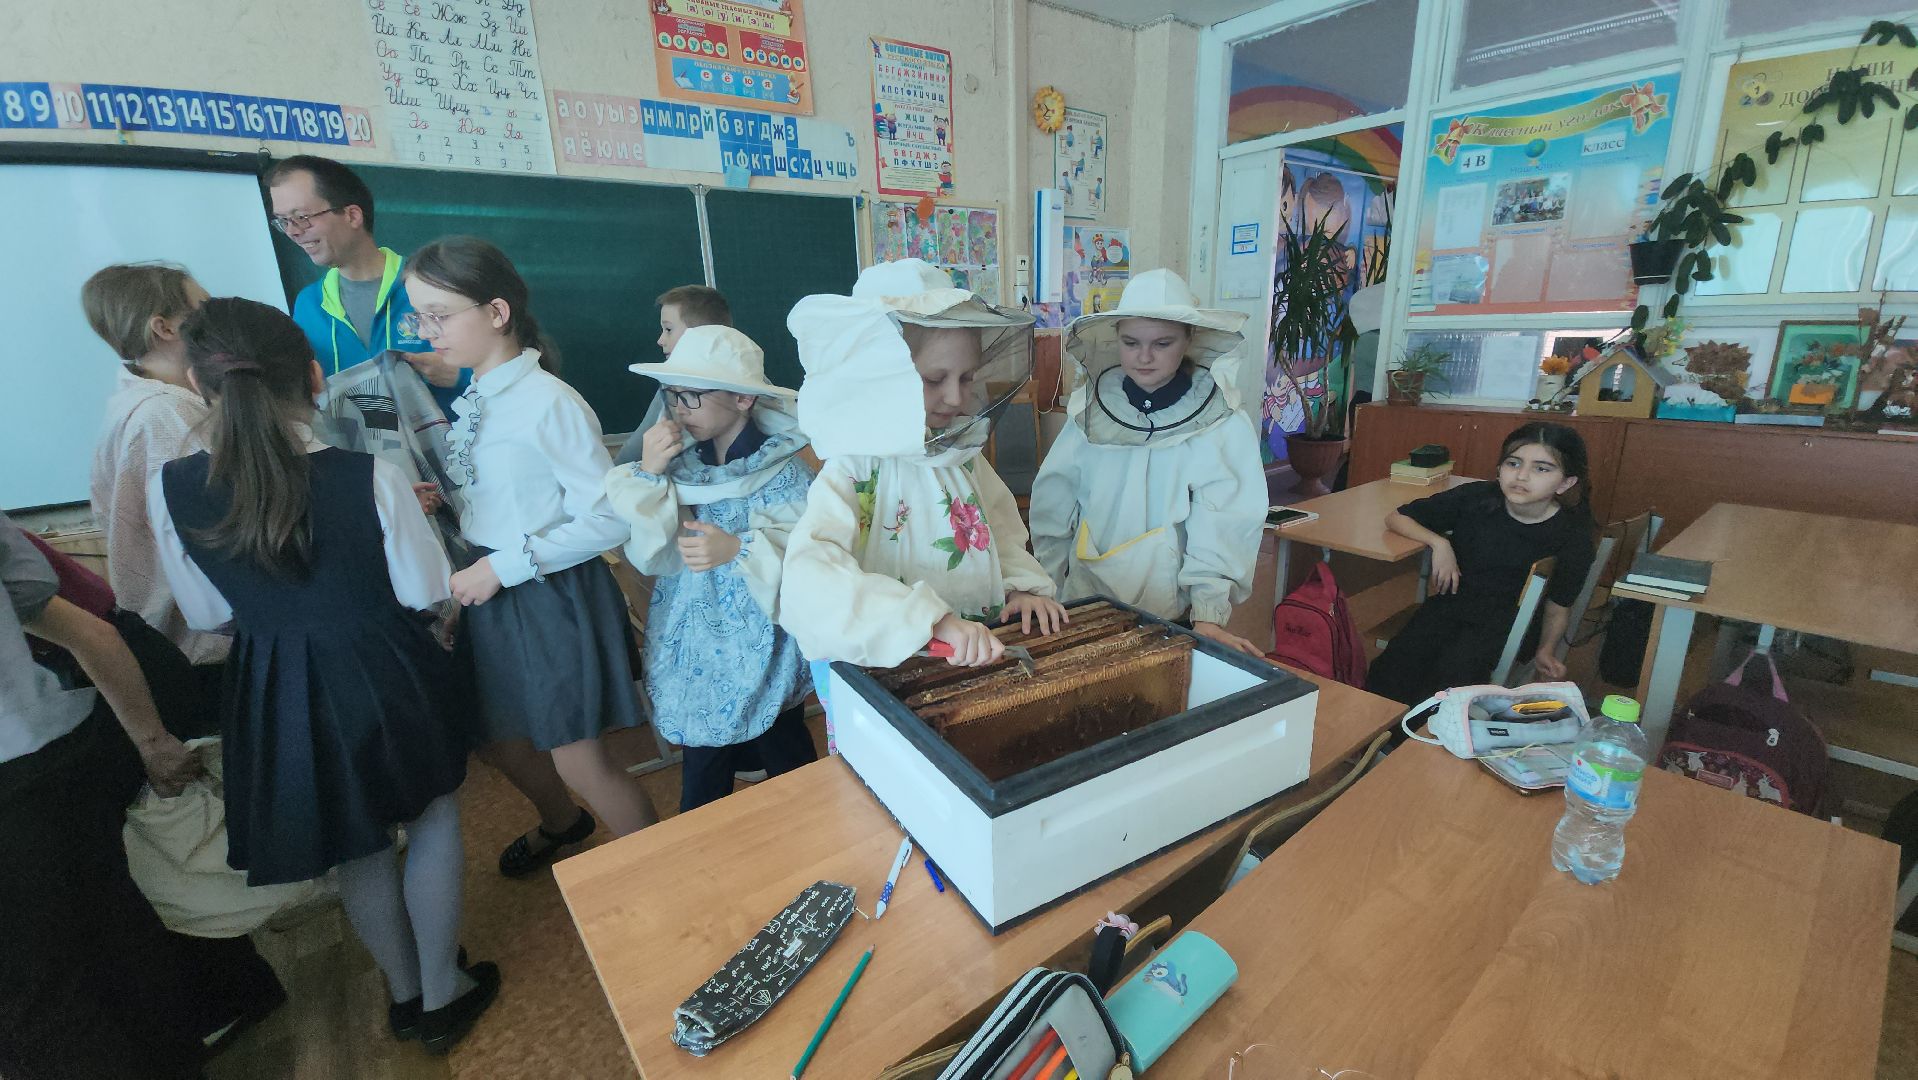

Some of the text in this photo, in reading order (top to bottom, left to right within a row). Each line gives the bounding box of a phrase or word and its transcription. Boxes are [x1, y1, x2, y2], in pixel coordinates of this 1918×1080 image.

[4, 90, 371, 142] 8 9 10 11 12 13 14 15 16 17 18 19 20
[558, 99, 854, 147] а о у ы э н м л р й б в г д ж з ъ
[565, 137, 577, 155] я
[580, 131, 592, 156] ё
[596, 139, 612, 158] ю
[617, 141, 629, 159] и
[633, 143, 643, 160] е
[752, 154, 760, 169] к
[763, 155, 771, 170] т
[775, 156, 786, 171] ш
[790, 157, 798, 172] с
[802, 158, 810, 173] х
[814, 160, 823, 178] ц
[826, 161, 834, 175] ч
[837, 161, 847, 179] щ
[850, 163, 856, 176] ь
[1462, 156, 1471, 168] 4
[1583, 138, 1625, 153] класс
